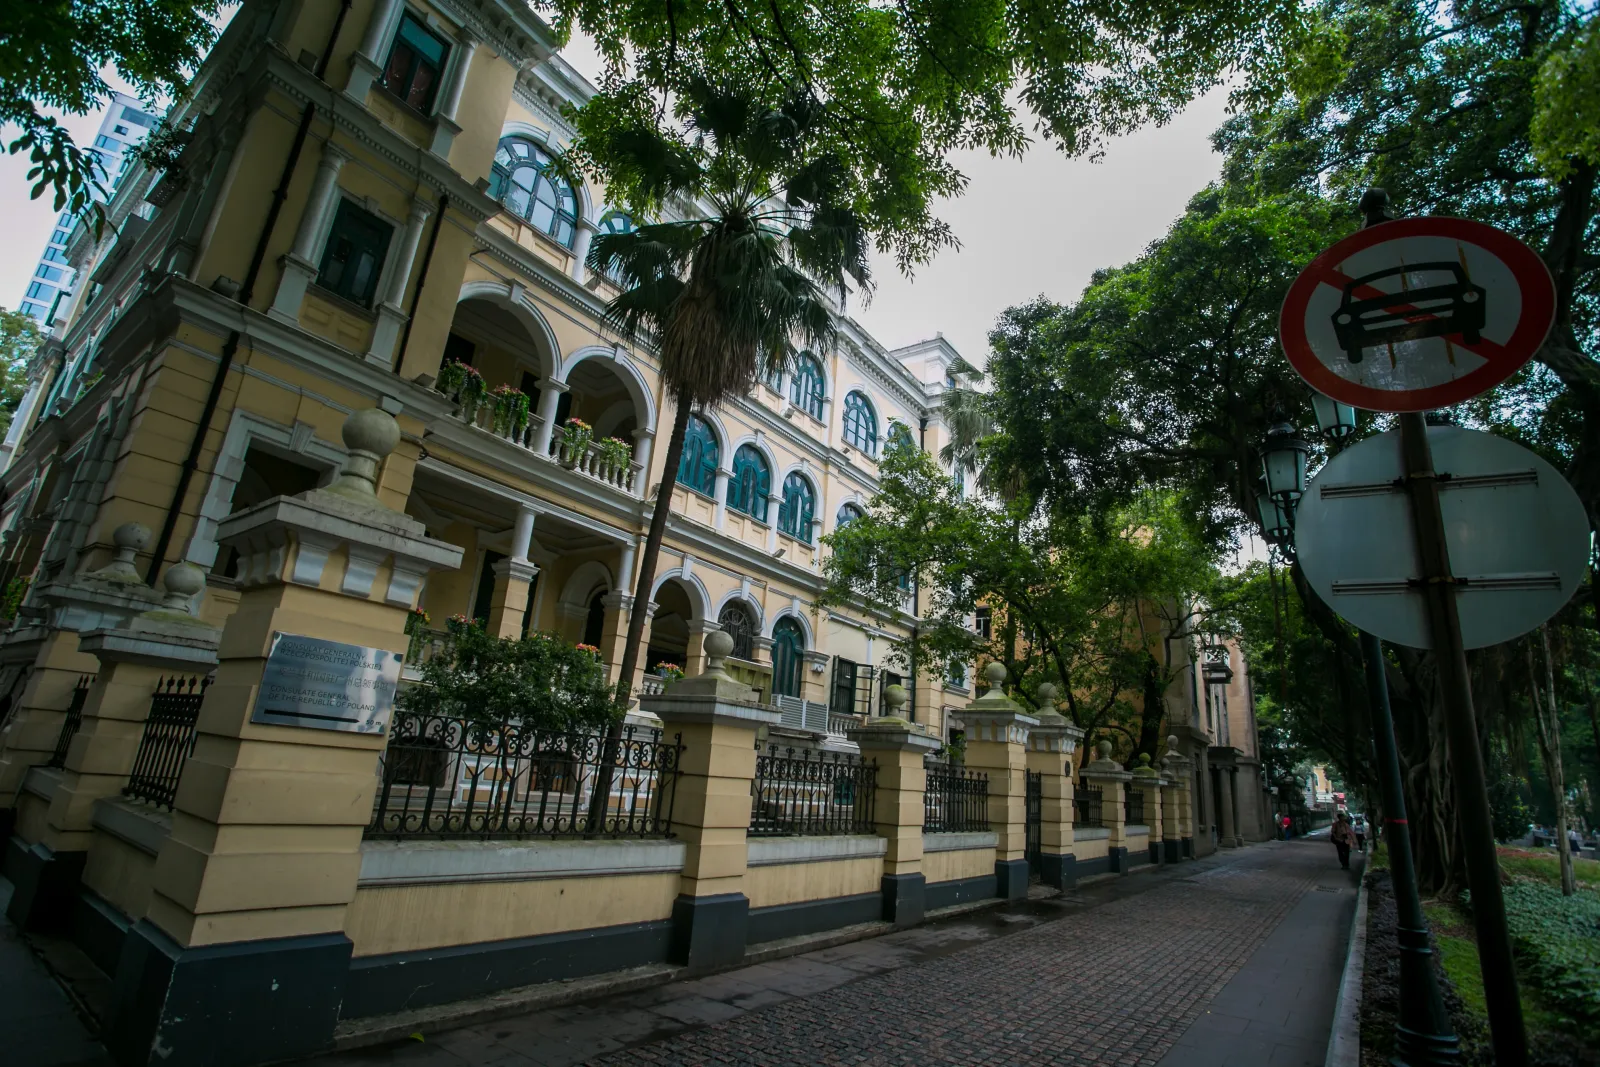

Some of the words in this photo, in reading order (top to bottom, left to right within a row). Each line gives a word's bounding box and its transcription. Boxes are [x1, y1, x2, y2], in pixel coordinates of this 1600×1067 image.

[280, 648, 348, 664] RZECZPOSPOLITEJ
[350, 660, 382, 670] POLSKIEJ
[282, 641, 322, 654] KONSULAT
[324, 648, 366, 660] GENERALNY
[268, 692, 278, 700] OF
[282, 694, 296, 702] THE
[298, 696, 336, 706] REPUBLIC
[347, 702, 376, 712] POLAND
[270, 684, 316, 696] CONSULATE
[318, 691, 350, 702] GENERAL
